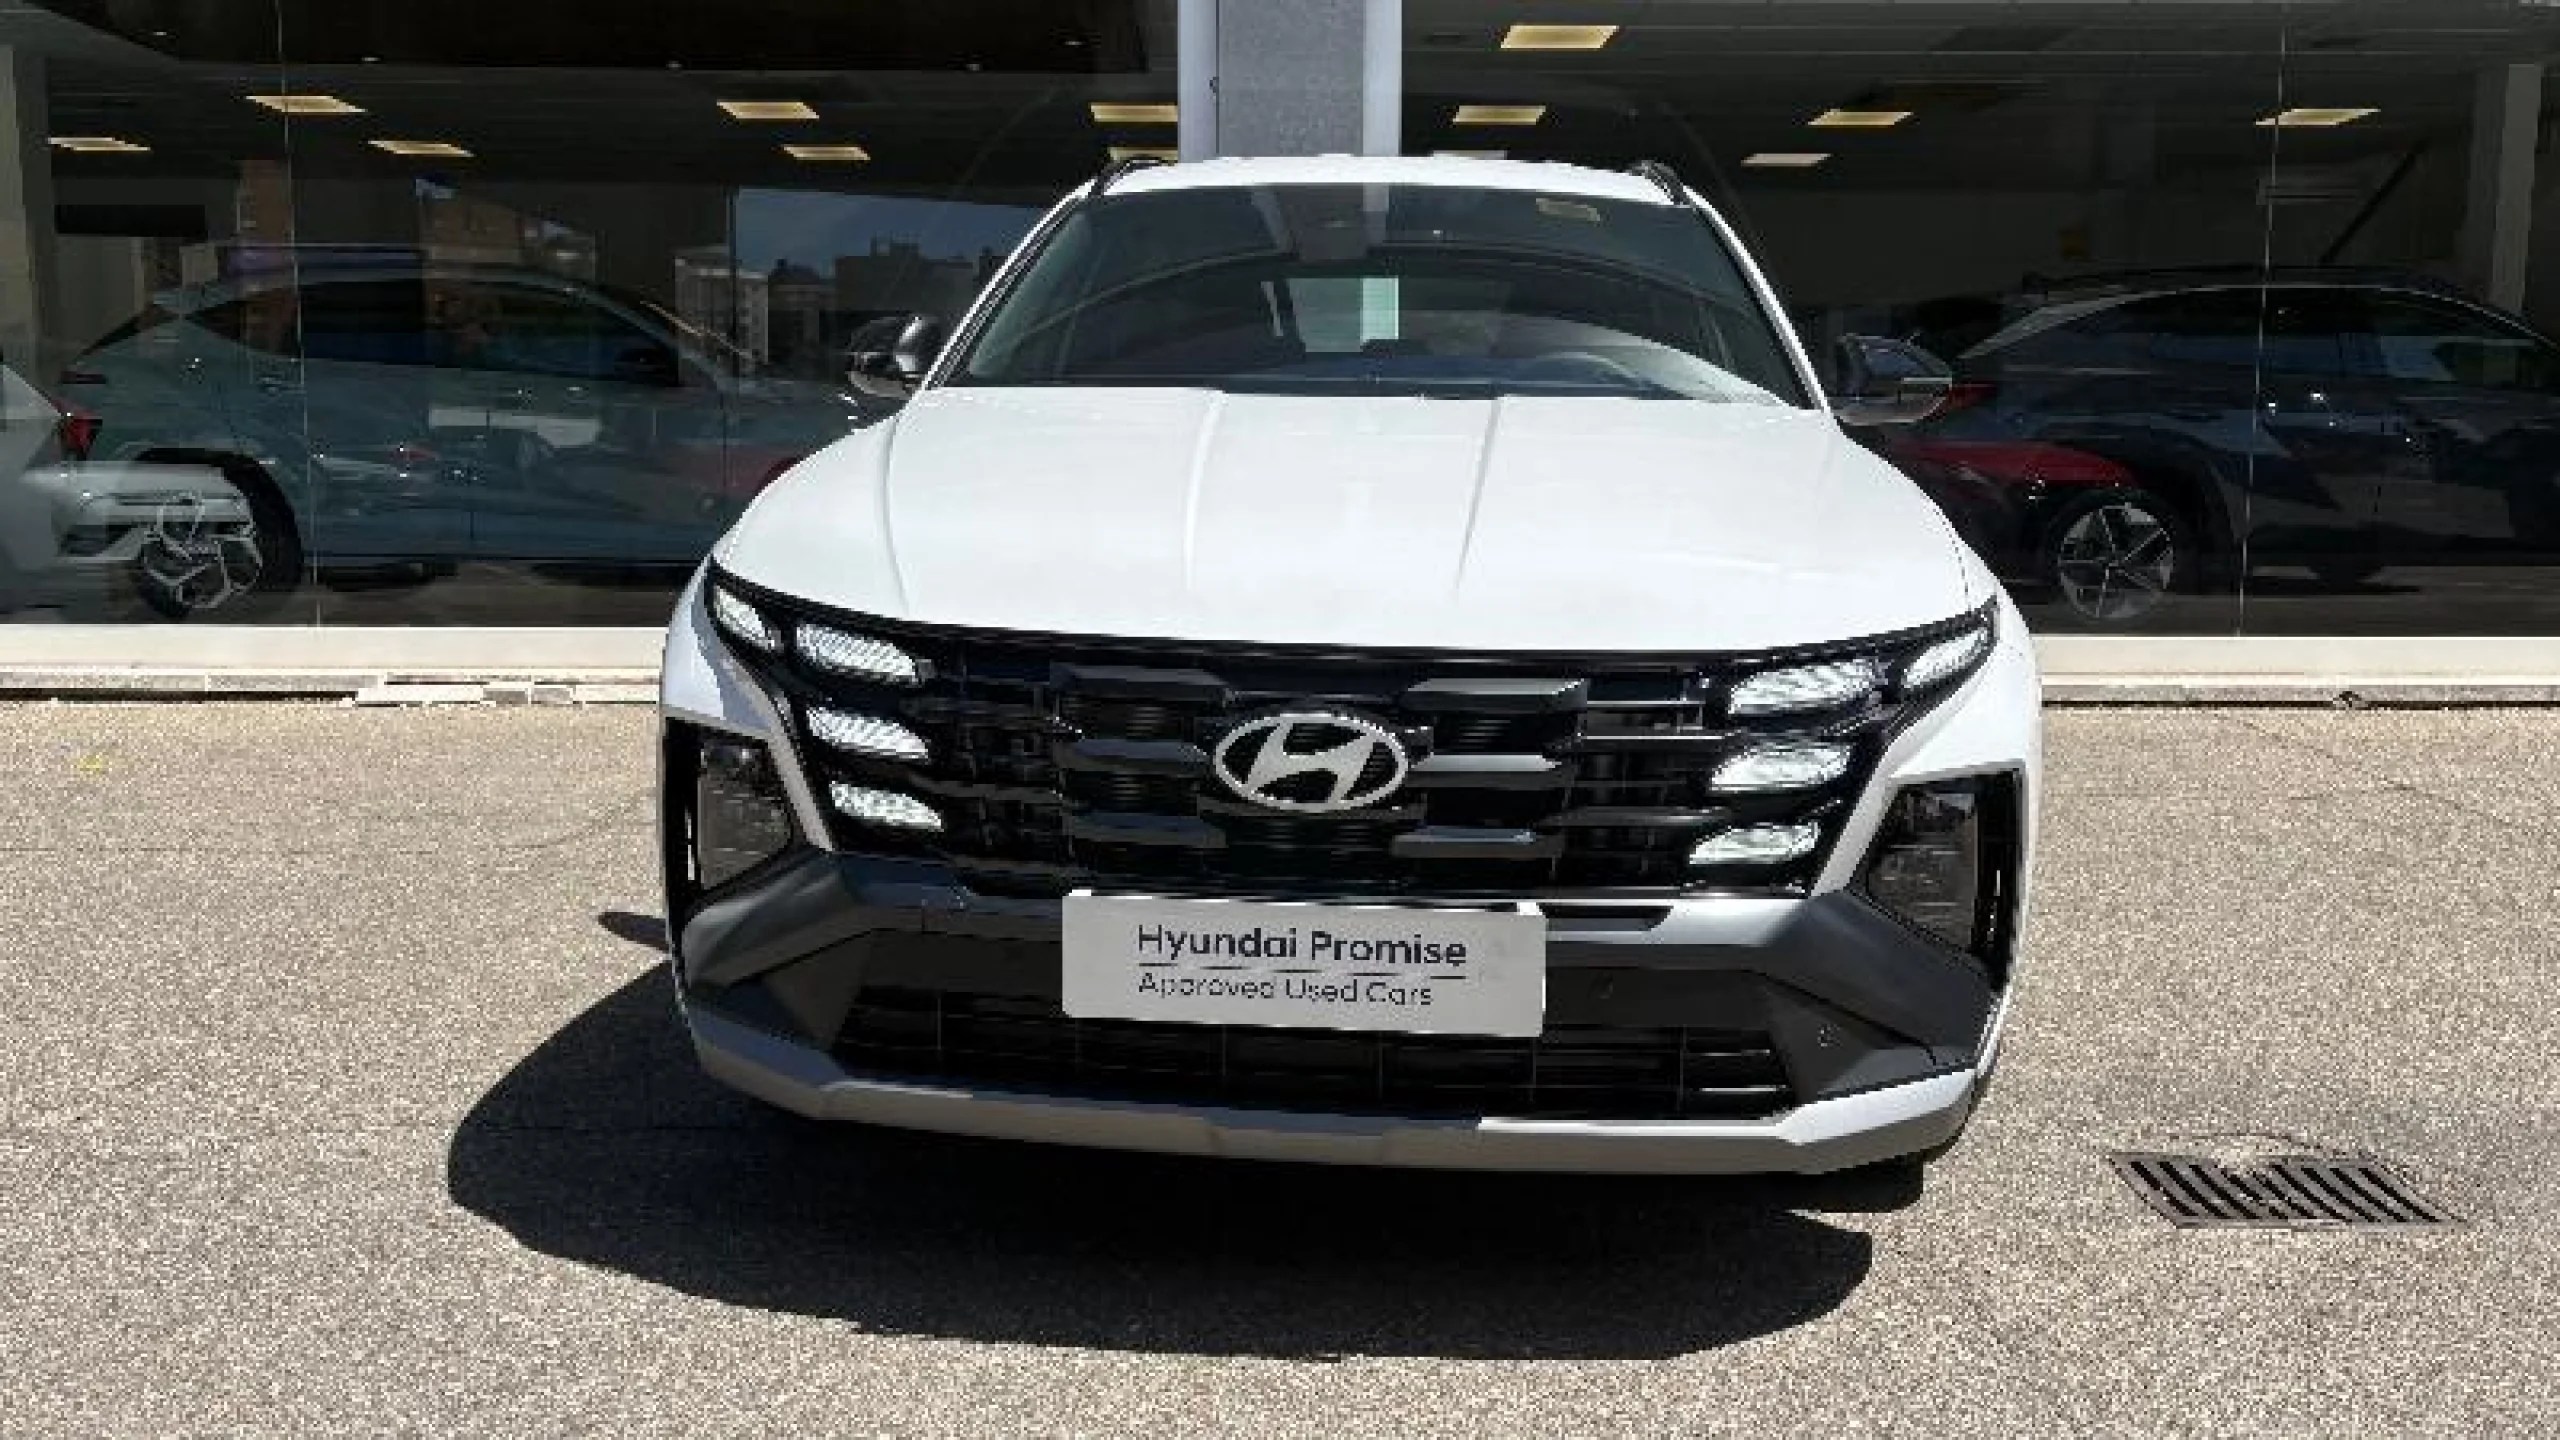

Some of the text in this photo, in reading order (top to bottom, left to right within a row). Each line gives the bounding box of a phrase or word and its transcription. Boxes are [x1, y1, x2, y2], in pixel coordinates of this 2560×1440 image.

[1138, 924, 1467, 966] Hyundai Promise
[1138, 973, 1433, 1006] Approved Used Cars
